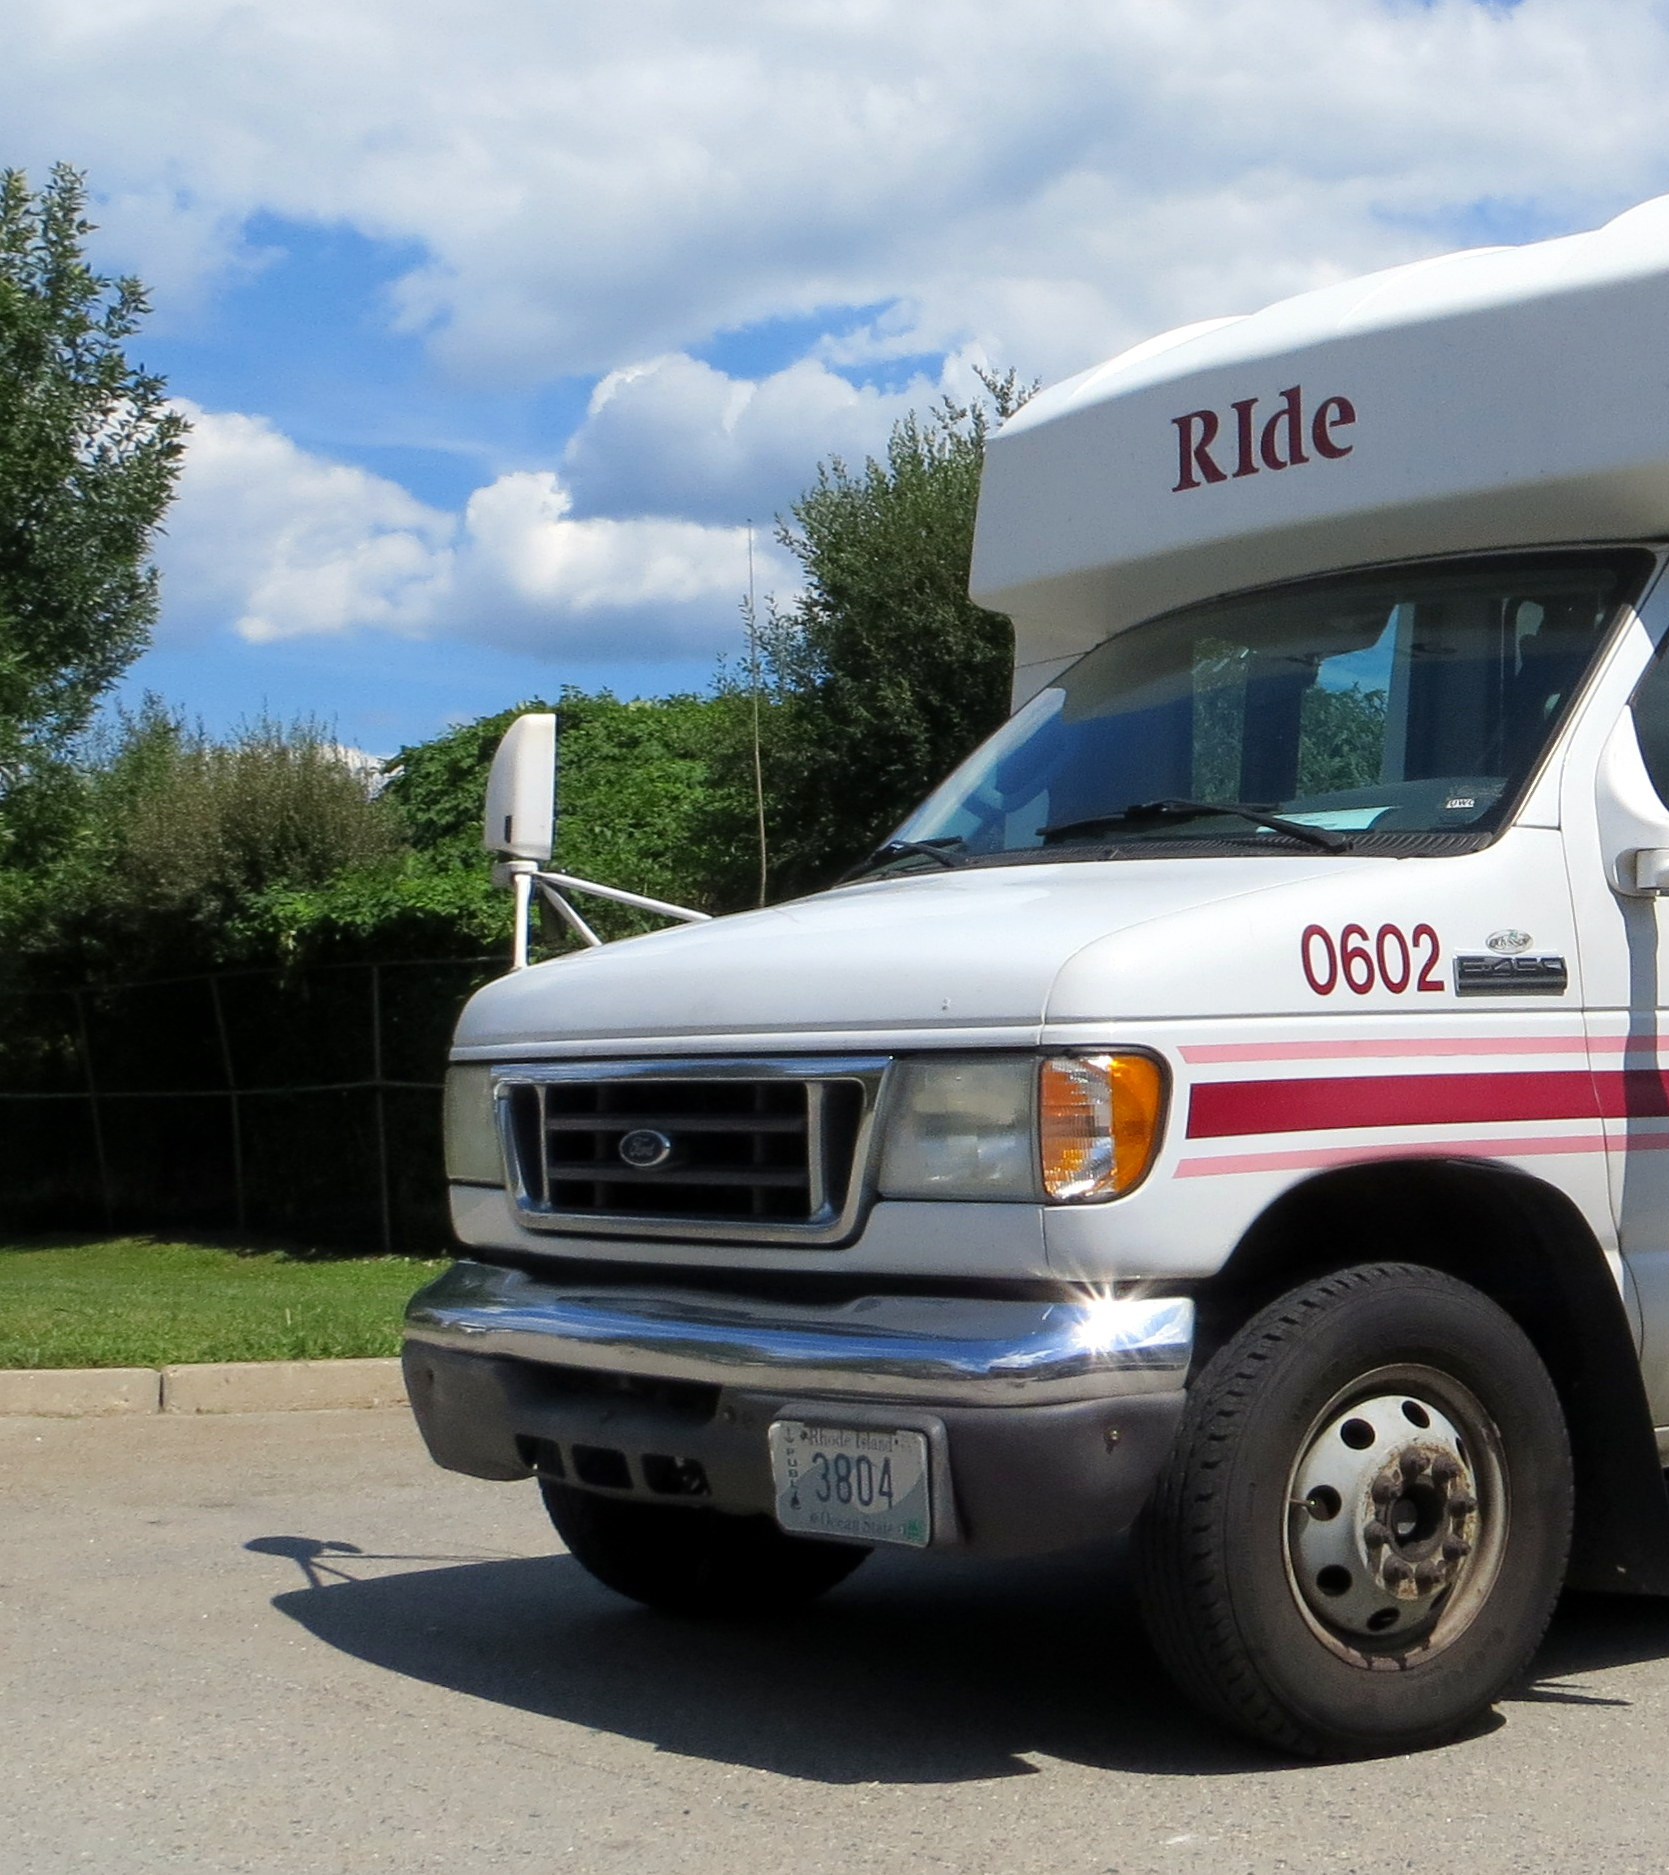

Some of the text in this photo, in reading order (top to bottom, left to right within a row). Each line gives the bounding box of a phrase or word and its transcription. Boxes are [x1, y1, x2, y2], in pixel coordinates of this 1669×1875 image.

[1171, 385, 1356, 493] RIde
[1301, 923, 1445, 995] 0602
[808, 1428, 893, 1451] Rhode Island
[812, 1452, 893, 1510] 3804
[820, 1512, 860, 1530] Ocean
